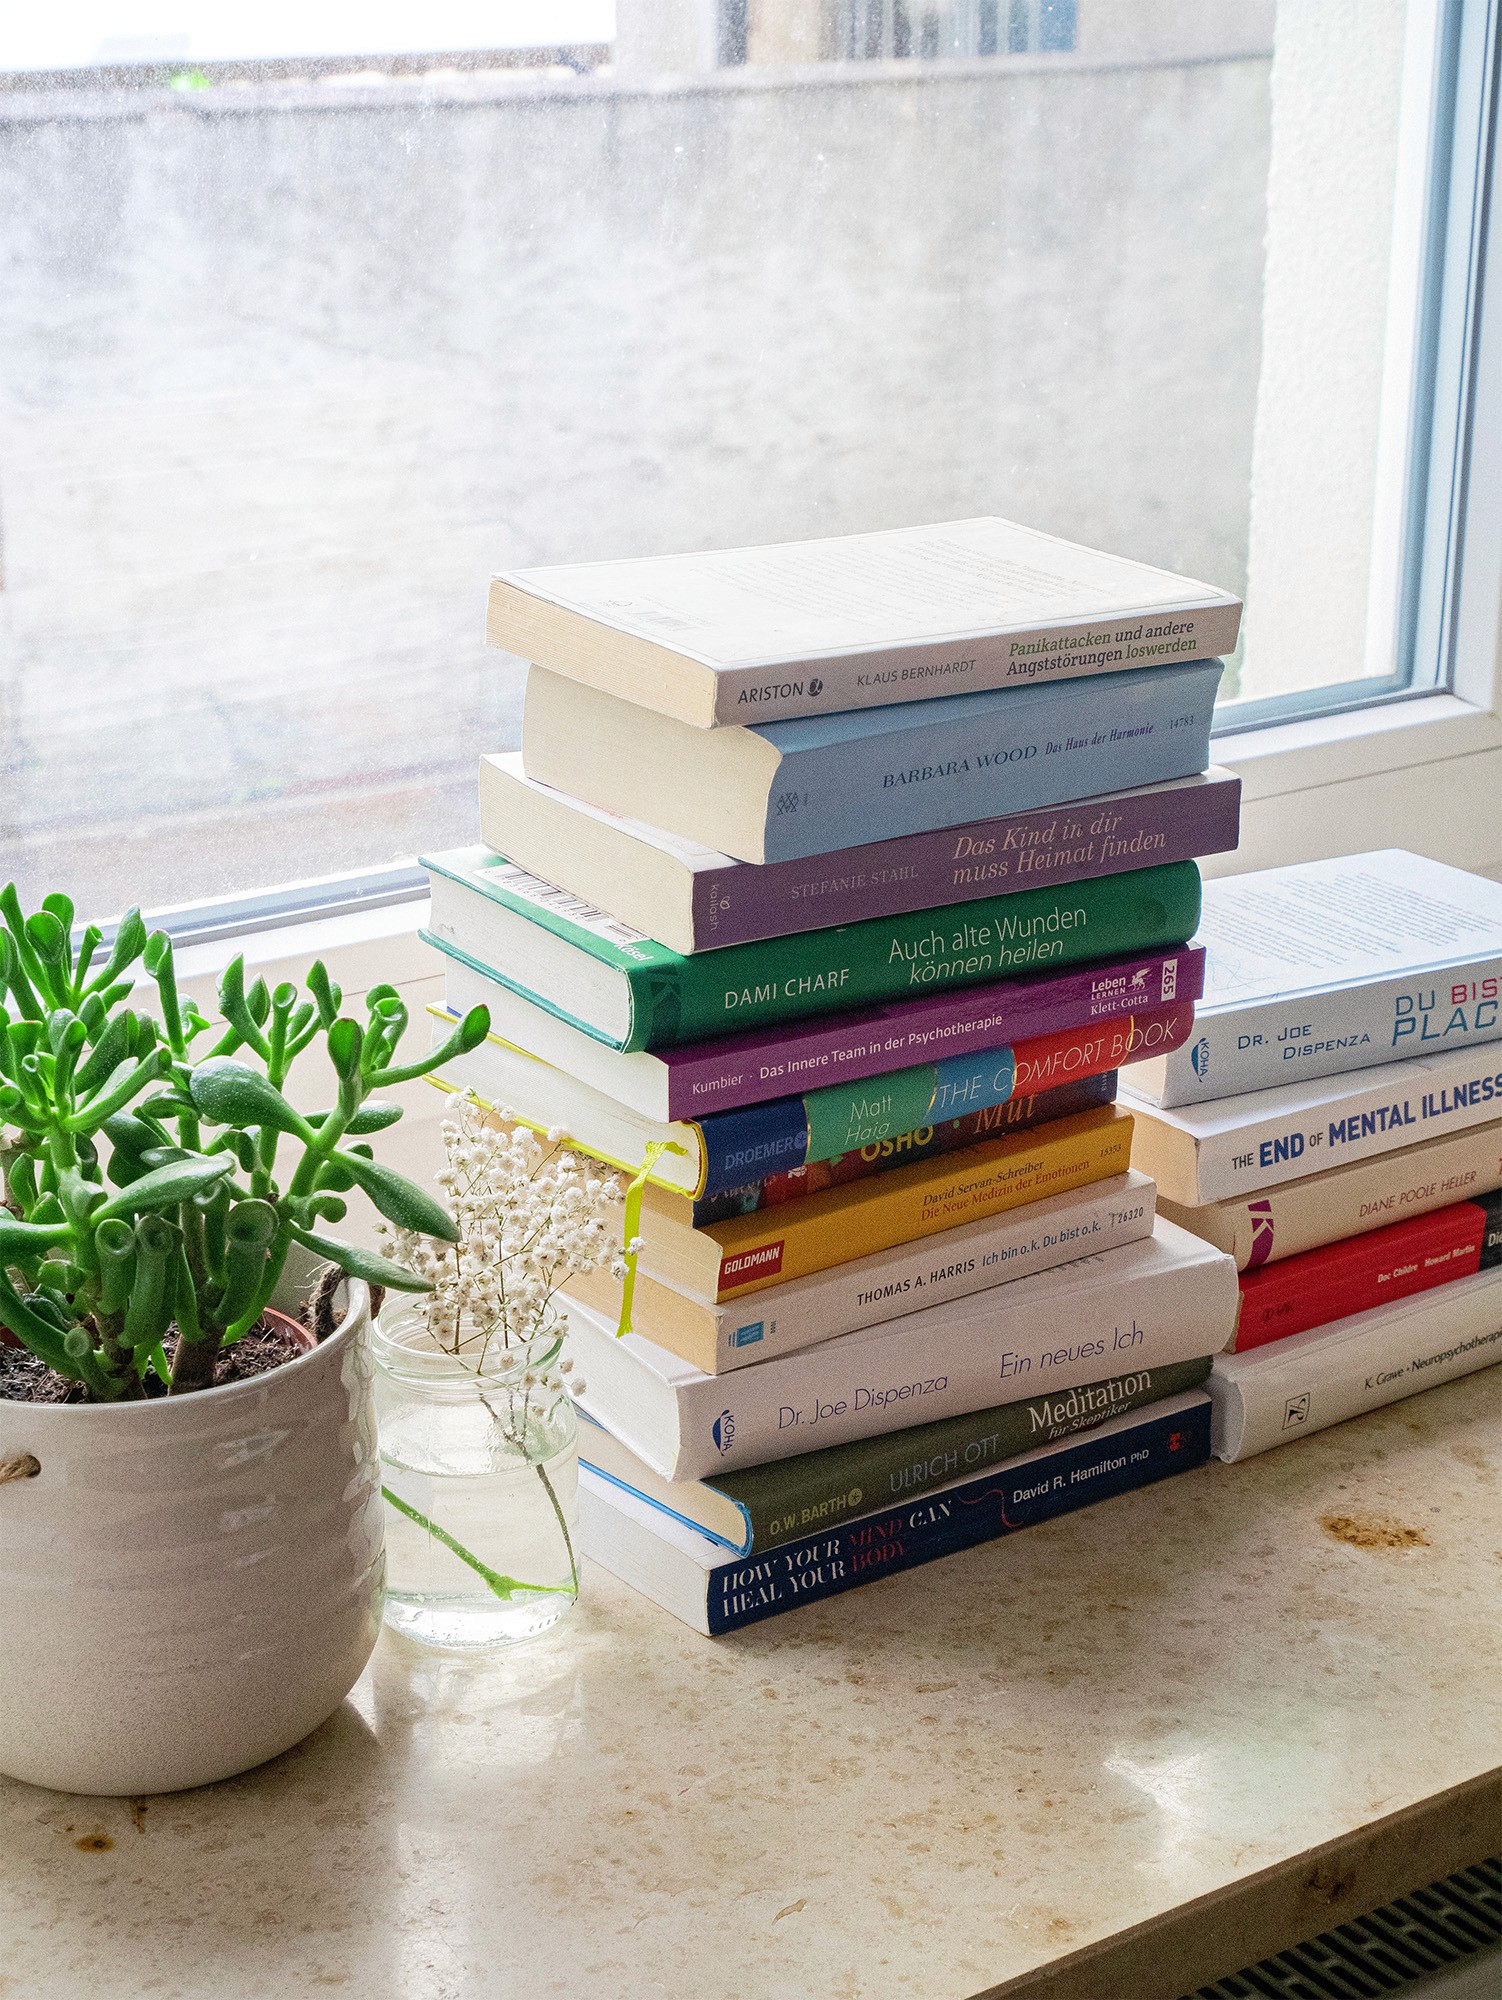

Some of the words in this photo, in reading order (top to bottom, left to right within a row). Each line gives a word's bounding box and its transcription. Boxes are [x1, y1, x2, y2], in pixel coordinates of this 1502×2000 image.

[1006, 650, 1123, 677] Angststörungen
[1125, 638, 1197, 659] loswerden
[1009, 632, 1111, 656] Panikattacken
[1115, 626, 1142, 643] und
[1145, 621, 1194, 638] andere
[737, 682, 804, 705] ARISTON
[857, 670, 898, 686] KLAUS
[901, 660, 977, 681] BERNHARDT
[1169, 715, 1195, 730] 14783
[882, 759, 970, 789] BARBARA
[976, 745, 1038, 769] WOOD
[1045, 741, 1063, 756] Das
[1065, 737, 1089, 752] Haus
[1092, 731, 1107, 745] der
[1109, 724, 1155, 742] Harmonie
[952, 836, 996, 860] Das
[1001, 822, 1057, 851] Kind
[1062, 819, 1083, 840] in
[1090, 812, 1123, 835] dir
[953, 862, 1008, 885] muss
[1016, 841, 1094, 875] Heimat
[1100, 830, 1167, 863] finden
[791, 874, 867, 899] STEFANIE
[871, 865, 919, 886] STAHL
[889, 930, 945, 963] Auch
[952, 924, 991, 951] alte
[995, 906, 1086, 942] Wunden
[909, 953, 991, 985] können
[999, 938, 1063, 967] heilen
[1163, 965, 1175, 994] 265
[725, 983, 777, 1009] DAMI
[784, 968, 850, 997] CHARF
[1090, 994, 1148, 1016] Klett-Cotta
[1091, 977, 1126, 993] Leben
[1091, 987, 1126, 1001] LERNEN
[1395, 990, 1435, 1016] DU
[1451, 976, 1502, 1005] BIS
[692, 1074, 743, 1095] Kumbier
[759, 1064, 784, 1080] Das
[787, 1056, 829, 1073] Innere
[831, 1047, 867, 1063] Team
[869, 1042, 881, 1054] in
[884, 1035, 905, 1051] der
[908, 1014, 1003, 1047] Psychotherapie
[940, 1075, 982, 1108] THE
[994, 1038, 1105, 1092] COMFORT
[1111, 1018, 1178, 1058] BOOK
[1199, 1041, 1210, 1077] KOHA
[850, 1095, 892, 1123] Matt
[860, 1125, 934, 1161] OSHO
[974, 1094, 1039, 1134] Mut
[1232, 1153, 1254, 1170] THE
[1259, 1133, 1304, 1167] END
[1309, 1132, 1324, 1147] OF
[1328, 1101, 1416, 1147] MENTAL
[1422, 1073, 1502, 1119] ILLNESS
[724, 1137, 793, 1171] DROEMER
[845, 1122, 891, 1146] Haig
[921, 1207, 940, 1221] Die
[942, 1199, 970, 1215] Neue
[971, 1185, 1013, 1205] Medizin
[1015, 1177, 1033, 1192] der
[1034, 1160, 1090, 1184] Emotionen
[923, 1187, 955, 1207] David
[957, 1160, 1044, 1194] Servan-Schreiber
[1359, 1195, 1396, 1217] DIANE
[1399, 1182, 1436, 1205] POOLE
[1441, 1170, 1477, 1190] HELLER
[724, 1246, 780, 1275] GOLDMANN
[857, 1280, 911, 1306] THOMAS
[914, 1275, 926, 1289] A.
[929, 1258, 975, 1283] HARRIS
[982, 1251, 999, 1268] Ich
[1001, 1246, 1018, 1262] bin
[1020, 1240, 1040, 1256] o.k.
[1043, 1235, 1058, 1249] Du
[1059, 1227, 1080, 1243] bist
[1081, 1220, 1101, 1236] o.k.
[1377, 1273, 1391, 1283] Doc
[1000, 1352, 1031, 1378] Ein
[1040, 1340, 1104, 1368] neues
[1113, 1320, 1144, 1351] Ich
[1376, 1368, 1404, 1386] Grawe
[779, 1406, 804, 1429] Dr.
[810, 1399, 847, 1425] Joe
[855, 1376, 948, 1411] Dispenza
[1027, 1371, 1152, 1433] Meditation
[1049, 1425, 1068, 1440] für
[1072, 1401, 1131, 1431] Skeptiker
[724, 1415, 735, 1451] KOHA
[889, 1450, 958, 1492] ULRICH
[964, 1433, 999, 1463] OTT
[1013, 1481, 1049, 1504] David
[1053, 1476, 1066, 1490] R.
[1071, 1457, 1126, 1483] Hamilton
[1131, 1449, 1150, 1464] PhD
[722, 1558, 777, 1593] HOW
[785, 1539, 840, 1570] YOUR
[850, 1518, 904, 1548] MIND
[909, 1501, 952, 1528] CAN
[723, 1582, 783, 1617] HEAL
[789, 1560, 846, 1593] YOUR
[852, 1540, 906, 1572] BODY
